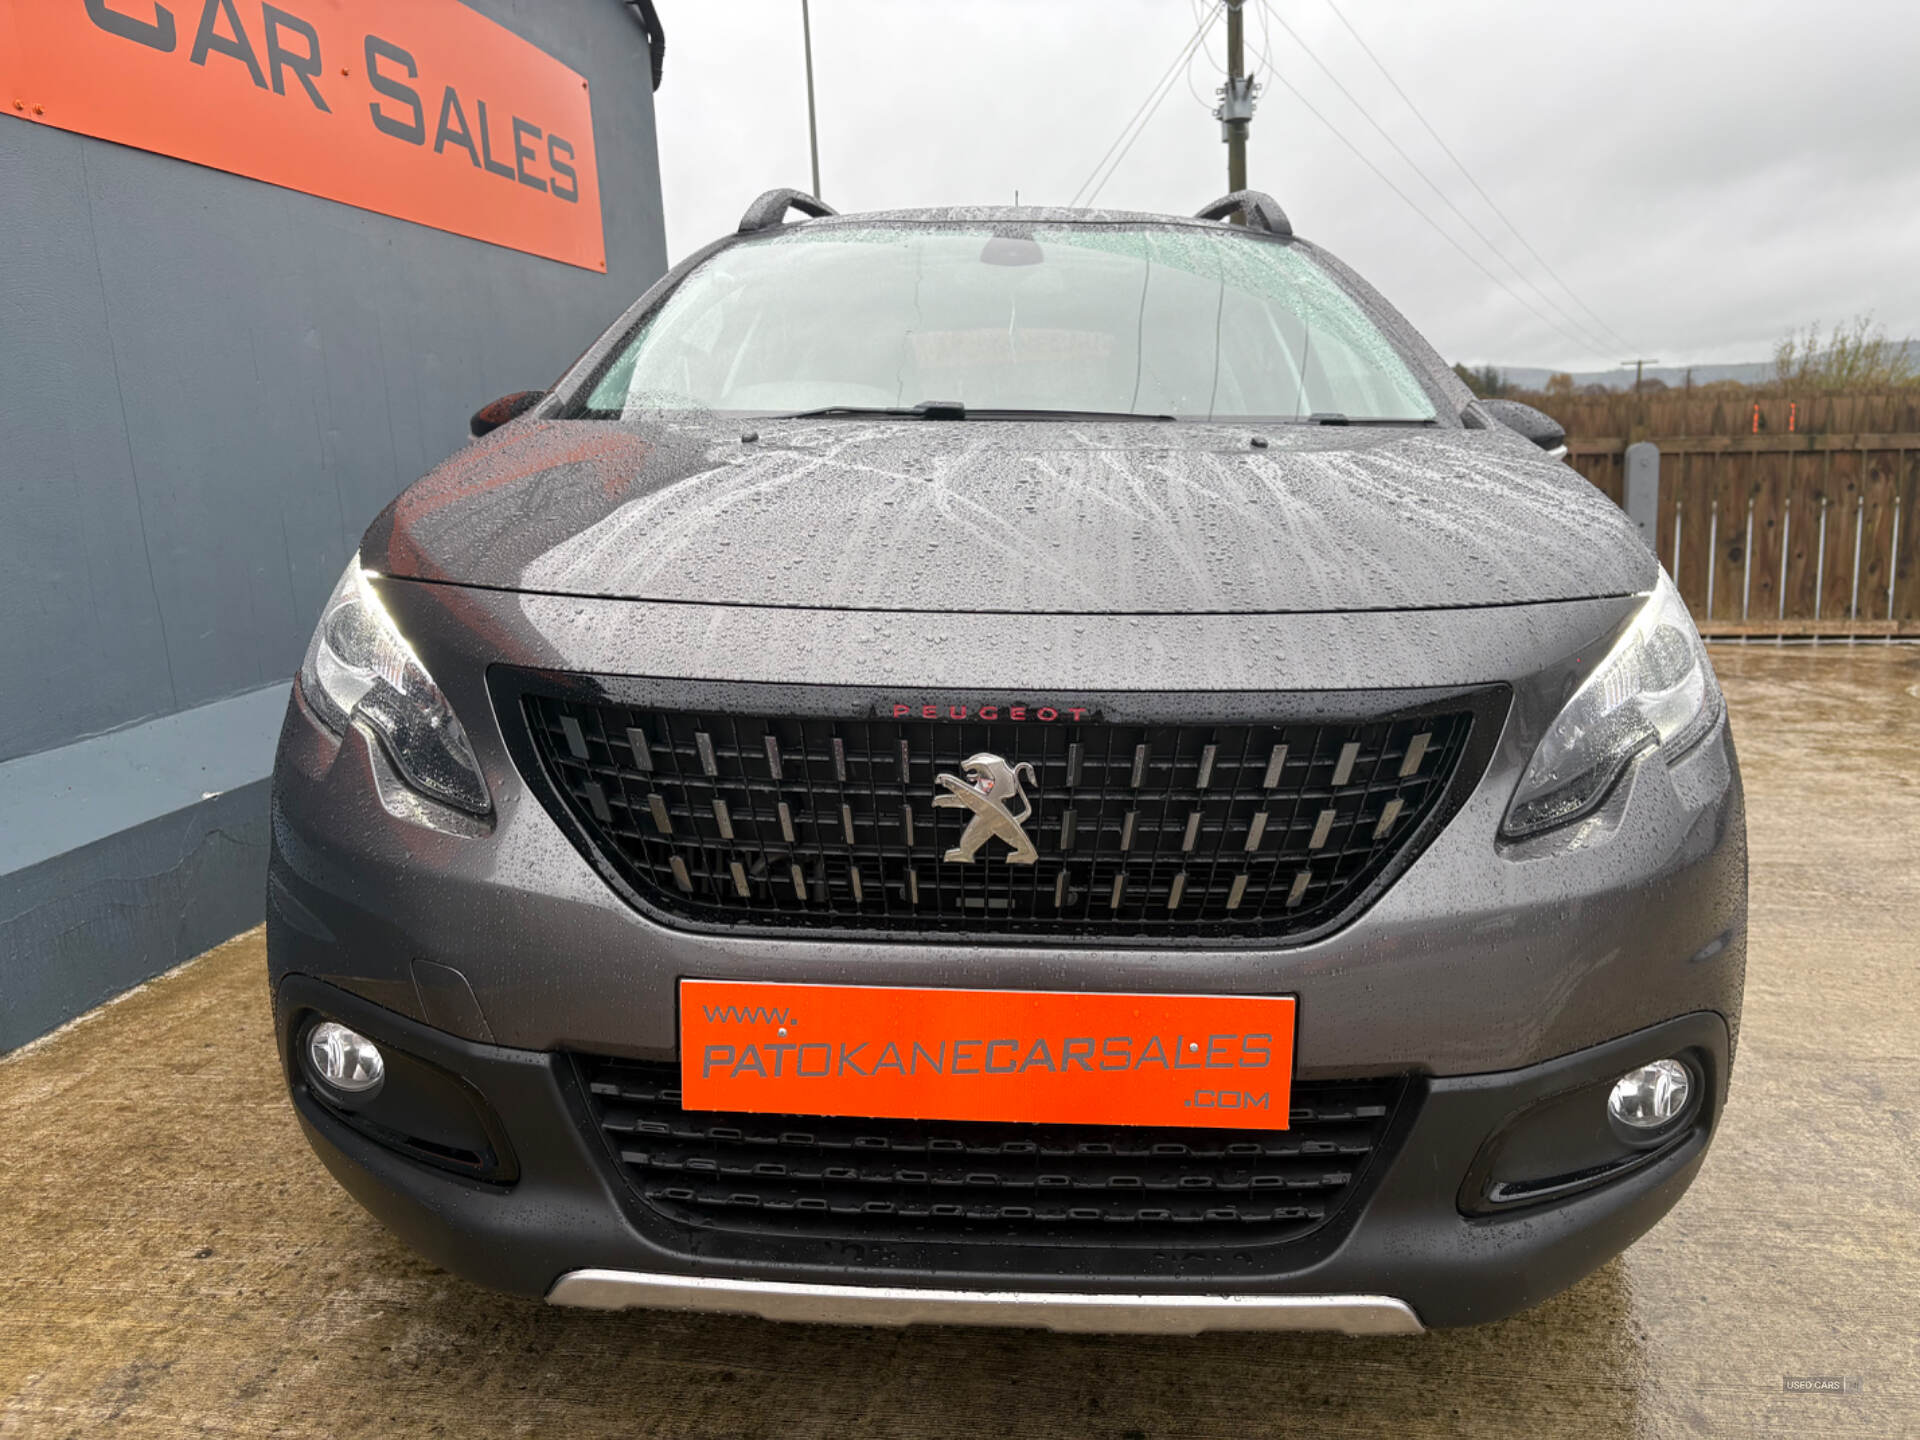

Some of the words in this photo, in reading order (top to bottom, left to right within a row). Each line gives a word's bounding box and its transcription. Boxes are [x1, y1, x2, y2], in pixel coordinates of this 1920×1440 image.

[364, 34, 579, 204] SALES
[893, 704, 1086, 721] PEUGEOT
[702, 1033, 1273, 1079] PATOKANECARSALES
[1184, 1090, 1270, 1110] .COM
